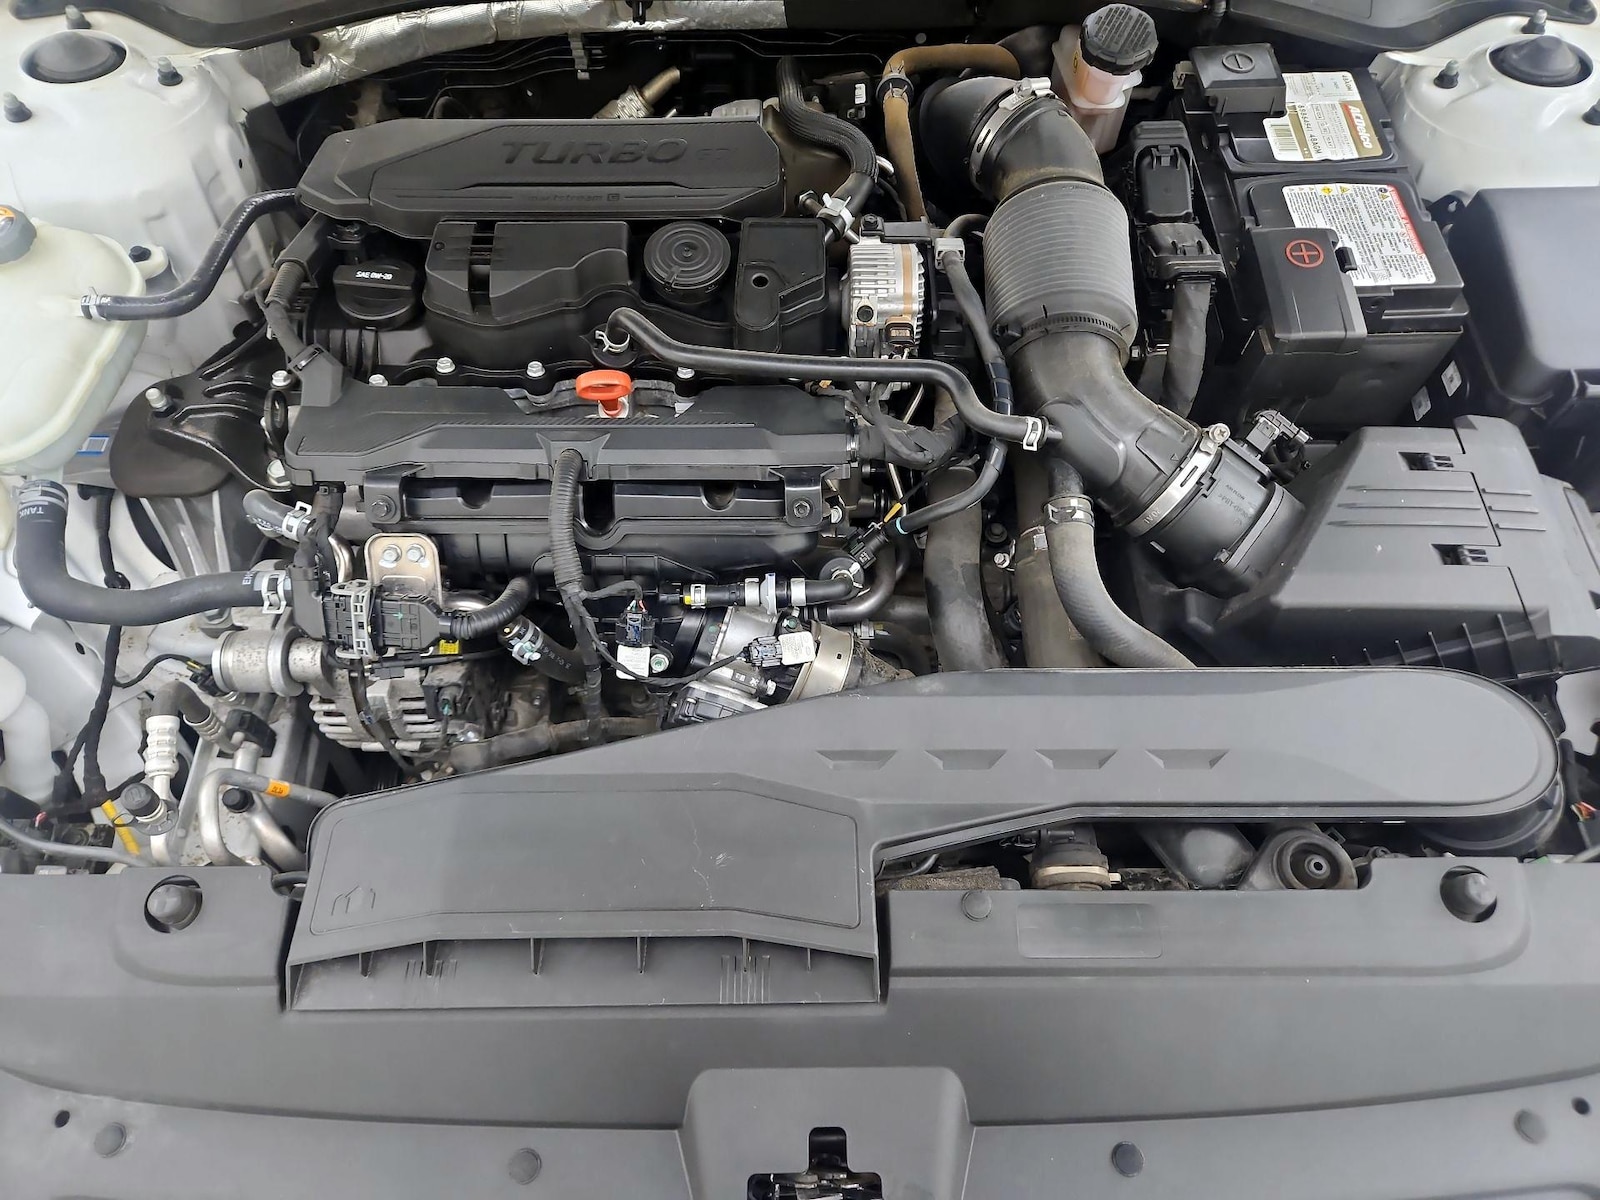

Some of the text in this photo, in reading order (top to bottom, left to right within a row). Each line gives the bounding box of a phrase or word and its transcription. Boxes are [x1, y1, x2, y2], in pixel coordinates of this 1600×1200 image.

[500, 138, 688, 164] TURBO
[355, 271, 370, 279] SAE
[19, 506, 45, 519] TANK
